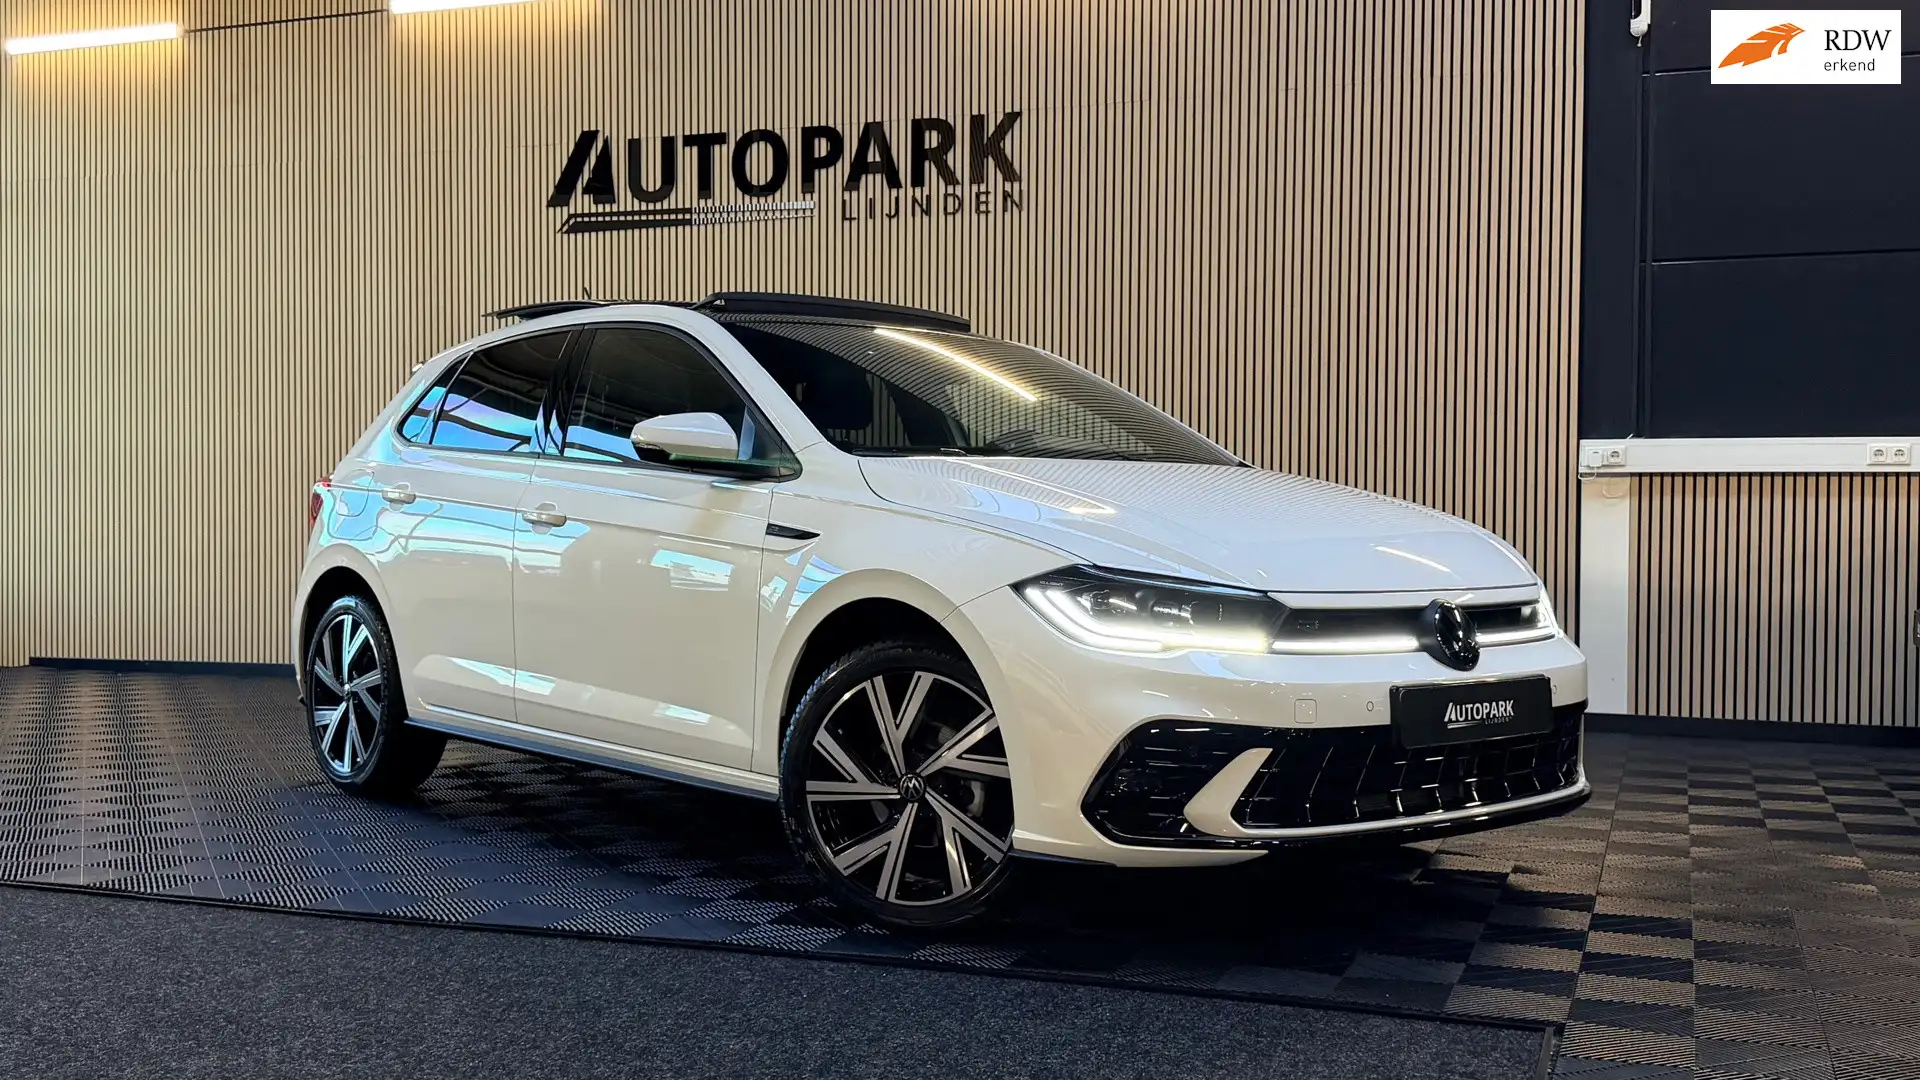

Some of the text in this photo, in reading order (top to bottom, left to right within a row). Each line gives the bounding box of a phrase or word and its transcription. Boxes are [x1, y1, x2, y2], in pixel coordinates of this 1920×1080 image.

[546, 110, 1023, 208] AUTOPARK
[842, 189, 1023, 221] LIJNDEN
[1443, 699, 1515, 722] AUTOPARK
